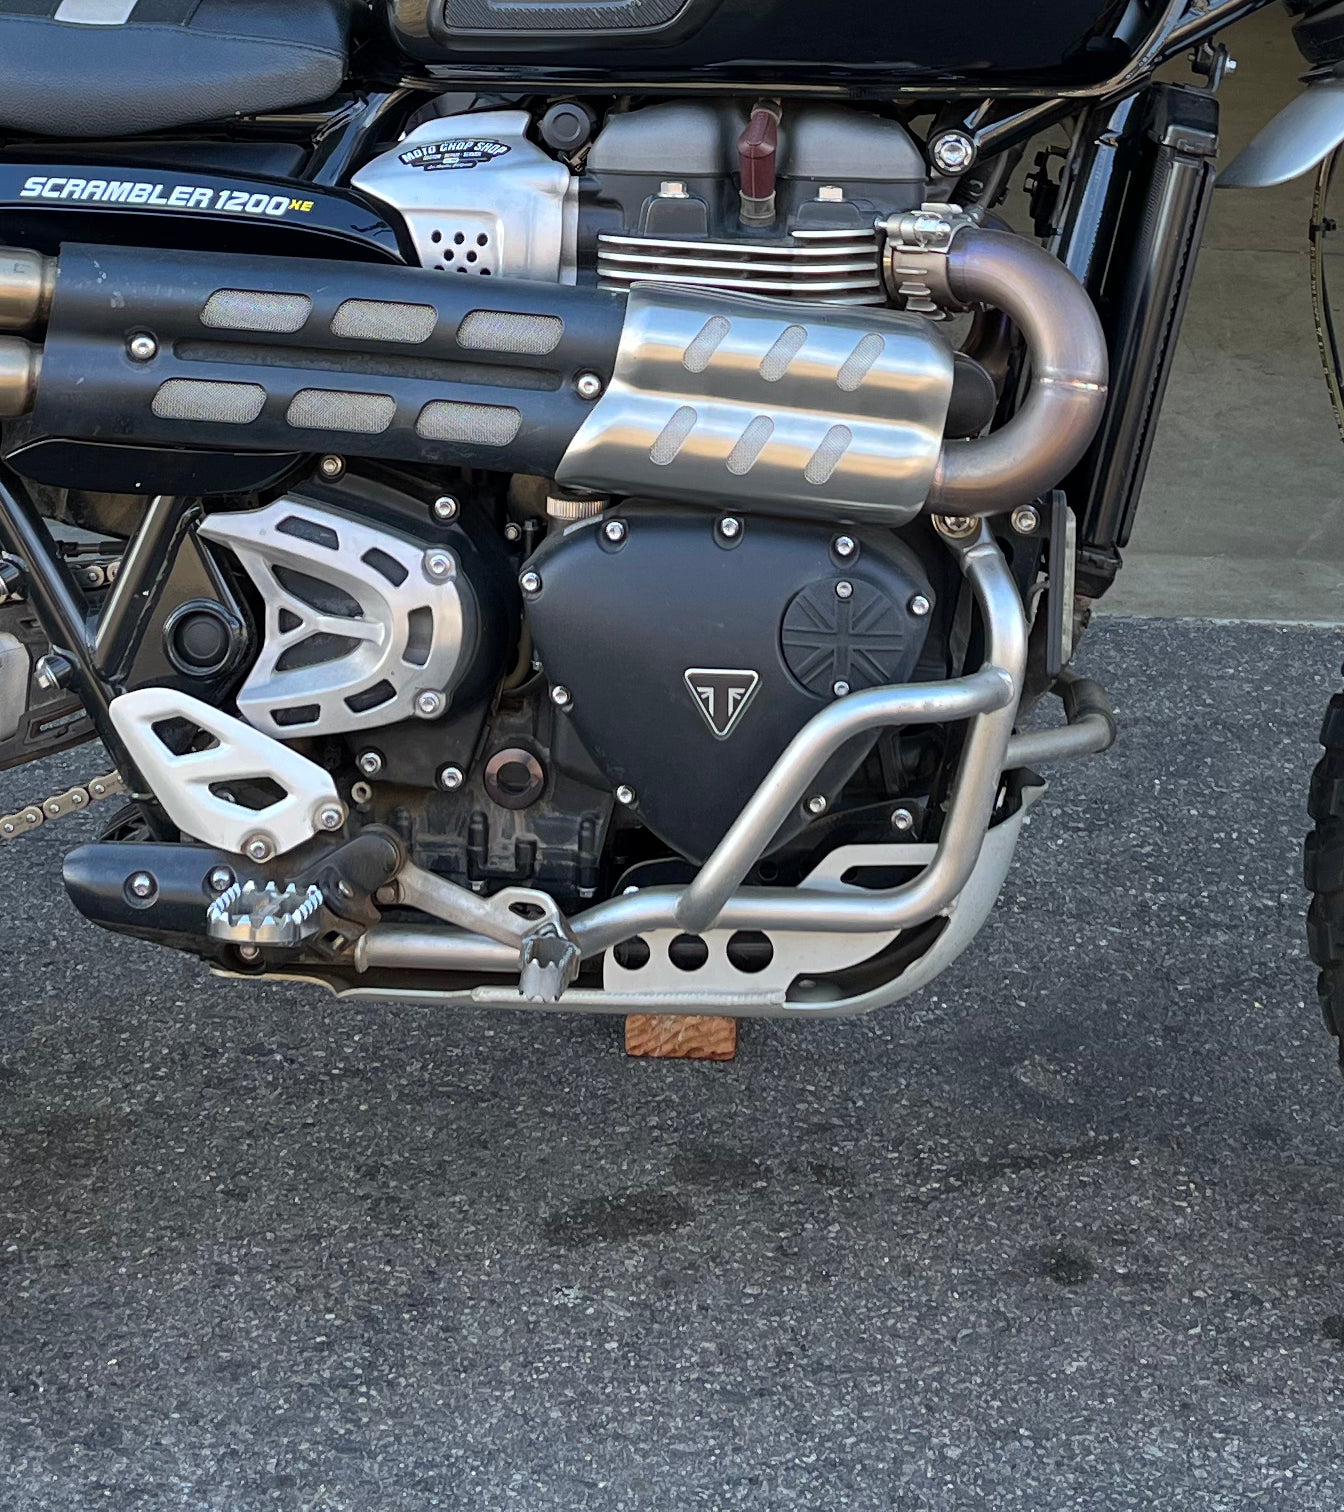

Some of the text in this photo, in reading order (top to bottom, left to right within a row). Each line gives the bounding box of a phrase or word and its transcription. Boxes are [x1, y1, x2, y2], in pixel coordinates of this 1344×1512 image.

[402, 145, 436, 163] MOTO
[440, 141, 474, 152] CHOP
[474, 141, 508, 155] SHOP
[20, 176, 314, 216] SCRAMBLER 1200 XE
